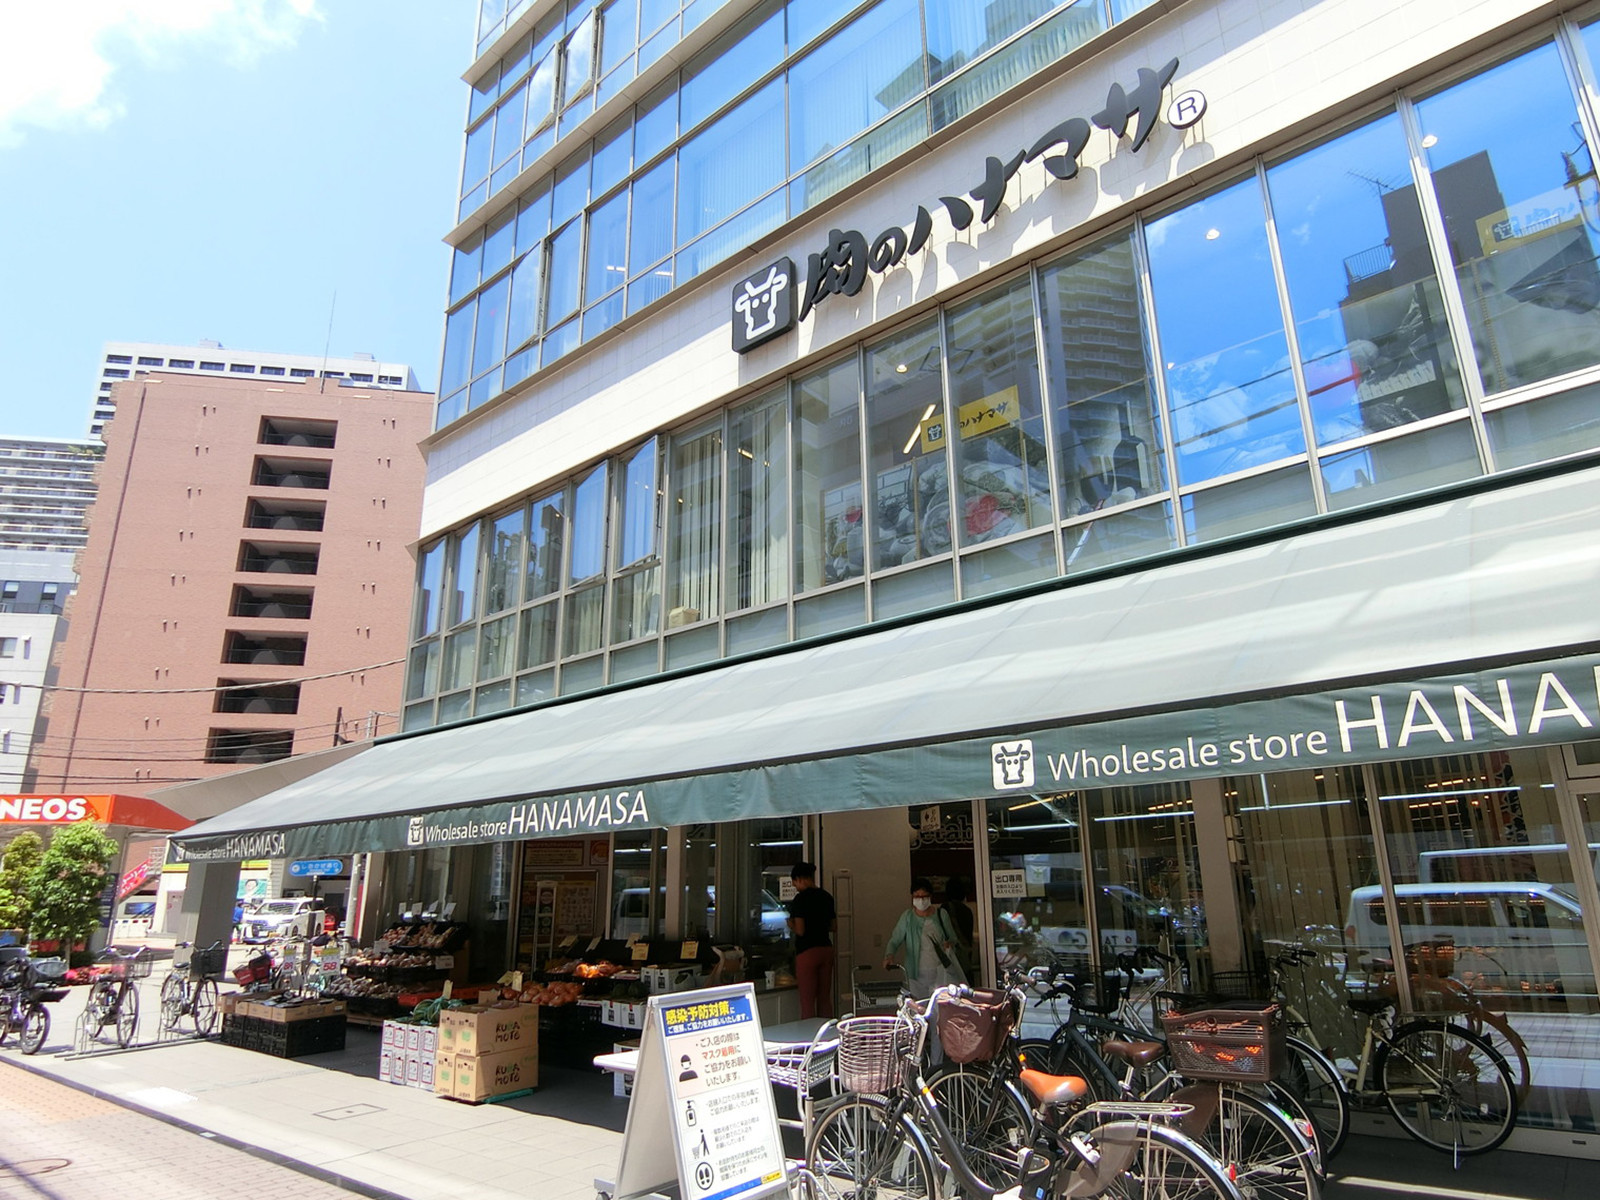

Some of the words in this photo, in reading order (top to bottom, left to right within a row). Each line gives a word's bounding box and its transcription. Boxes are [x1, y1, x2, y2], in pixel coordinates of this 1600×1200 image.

[798, 56, 1180, 322] 肉のハナマサ
[1047, 736, 1218, 781] Wholesale
[1229, 730, 1328, 764] store
[425, 820, 478, 843] Wholesale
[480, 820, 507, 838] store
[508, 790, 650, 835] HANAMASA
[226, 833, 286, 859] HANAMASA
[701, 1044, 742, 1060] マスク着用に
[704, 1056, 752, 1074] ご協力をお願い
